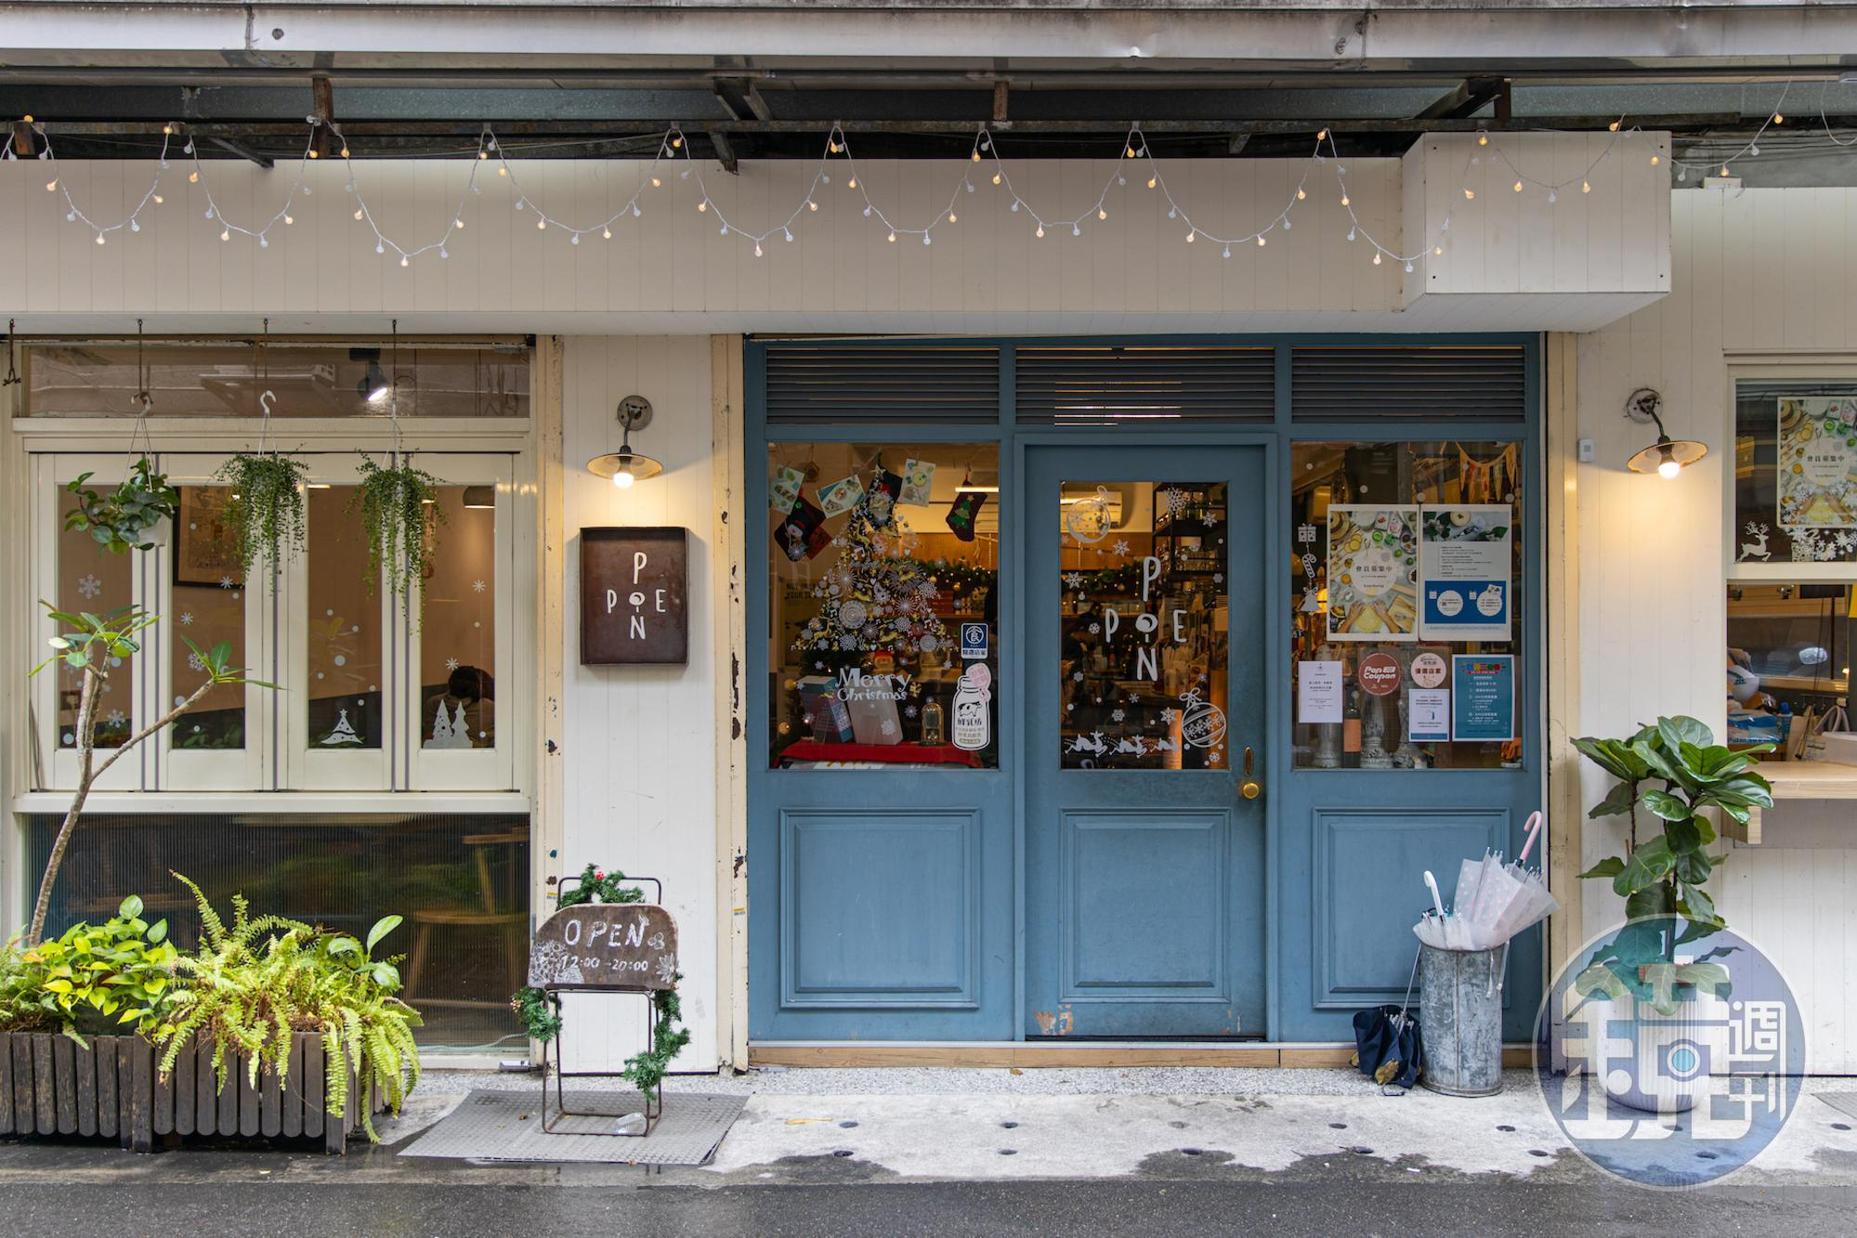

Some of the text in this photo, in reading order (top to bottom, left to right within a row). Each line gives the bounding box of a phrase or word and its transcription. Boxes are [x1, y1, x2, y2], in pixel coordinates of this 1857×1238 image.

[633, 552, 648, 584] P
[1143, 556, 1161, 602] P
[630, 615, 647, 640] N
[1136, 647, 1159, 682] N
[1363, 672, 1396, 683] Coupon
[836, 667, 913, 692] Merry
[836, 688, 908, 702] Christmas
[564, 915, 650, 949] OPEN
